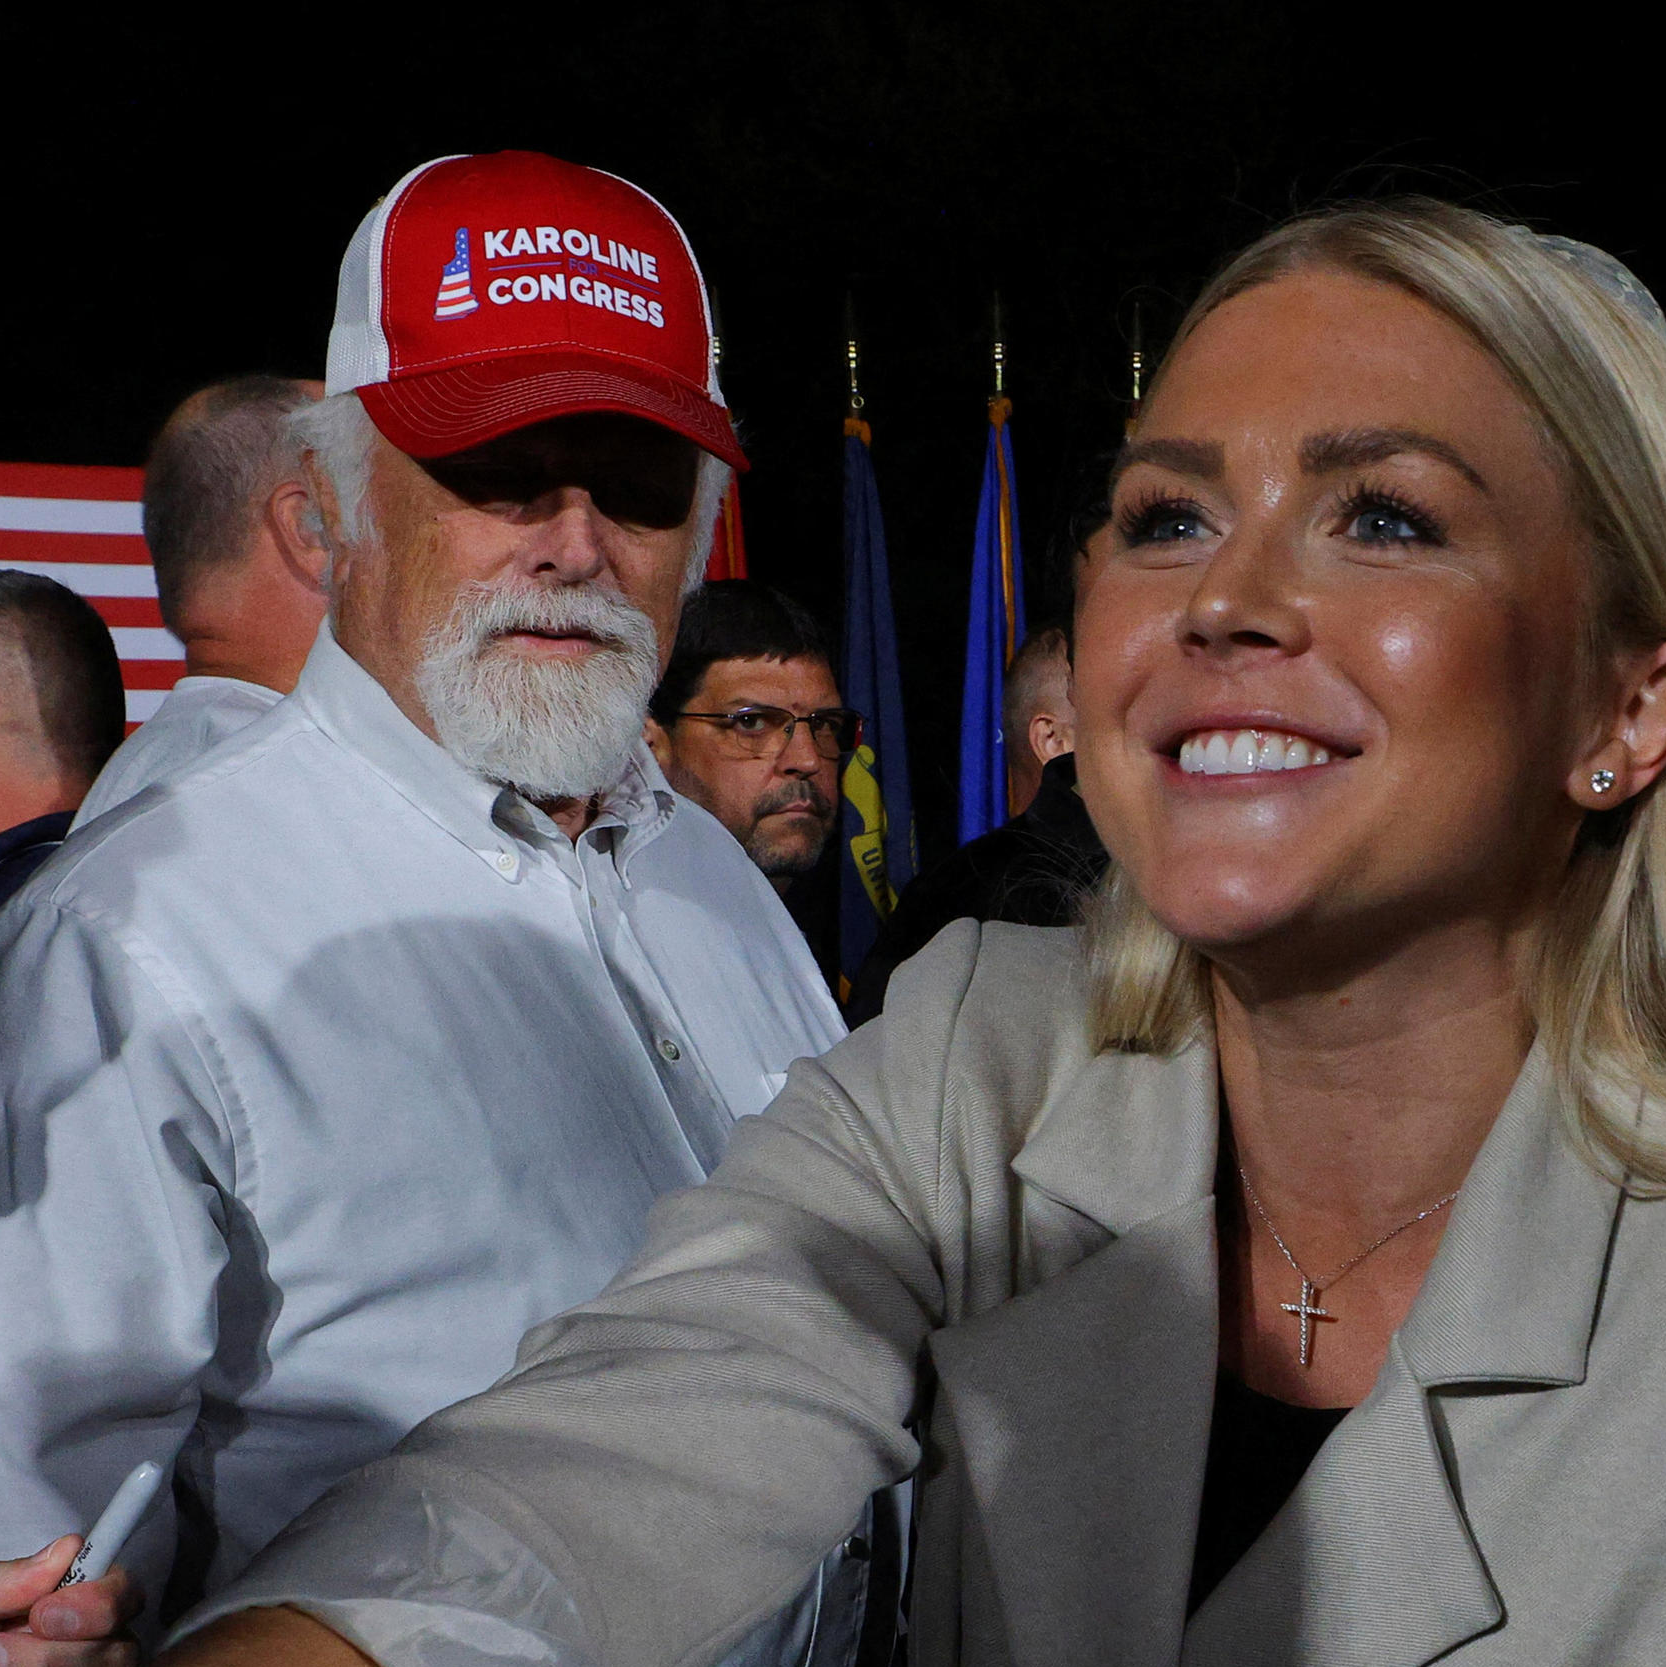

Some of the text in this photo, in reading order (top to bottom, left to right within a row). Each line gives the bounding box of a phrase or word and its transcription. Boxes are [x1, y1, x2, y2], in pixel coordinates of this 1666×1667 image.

[484, 226, 659, 283] KAROLINE
[569, 258, 598, 275] FOR
[487, 274, 664, 328] CONGRESS
